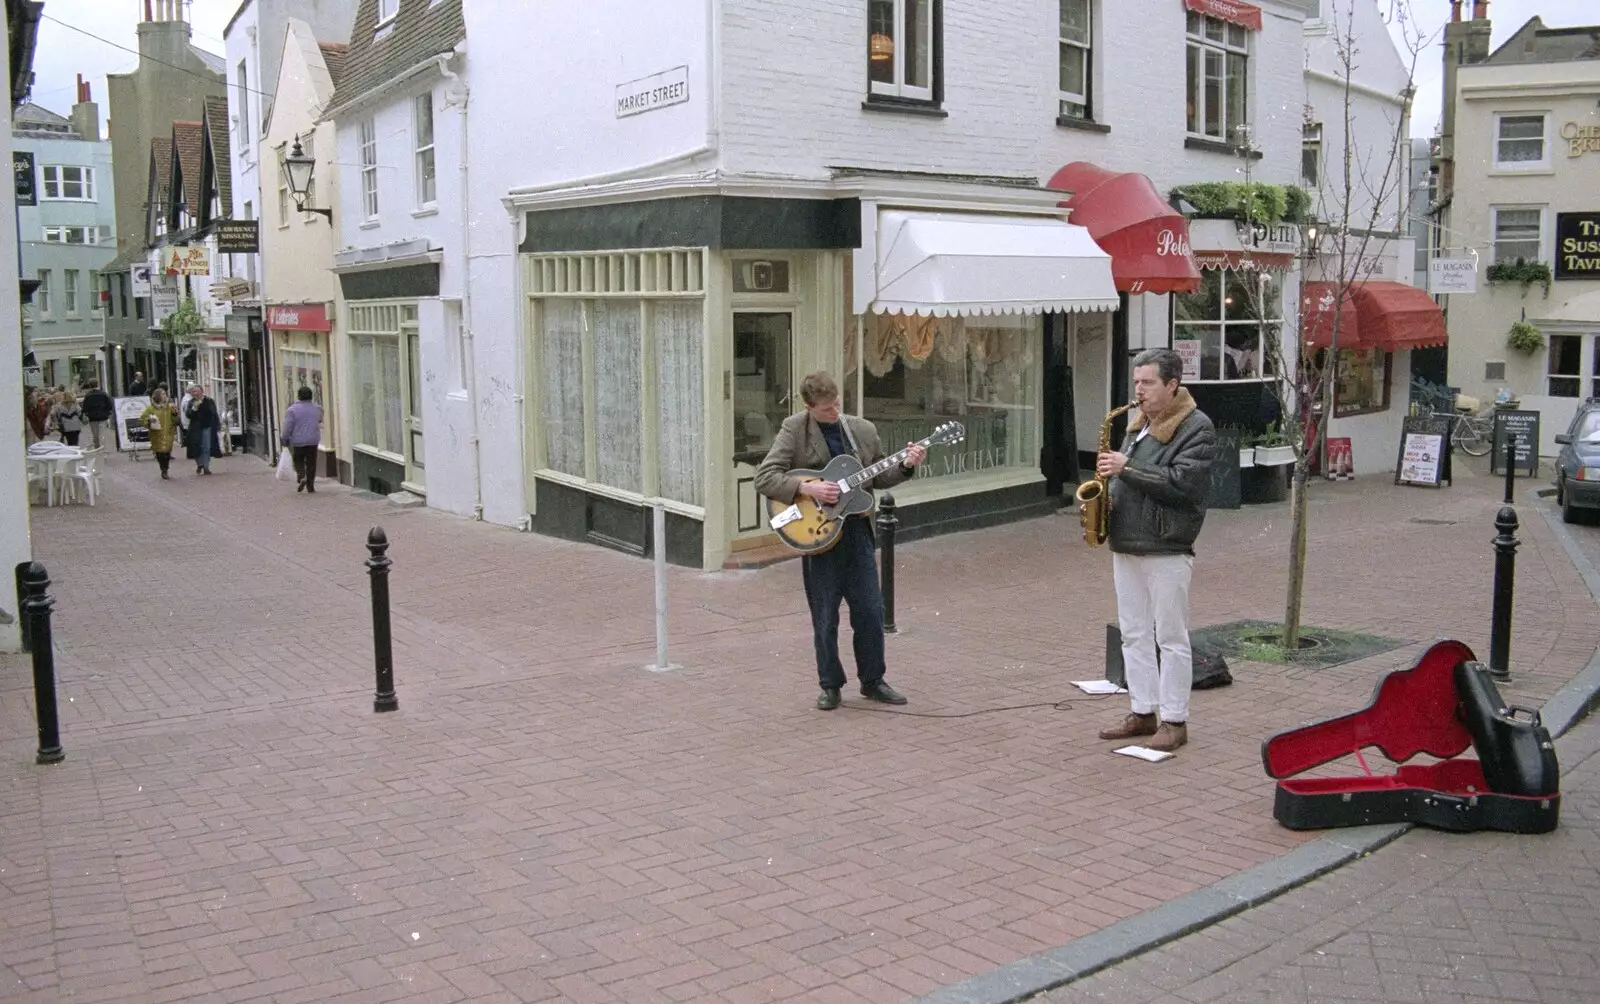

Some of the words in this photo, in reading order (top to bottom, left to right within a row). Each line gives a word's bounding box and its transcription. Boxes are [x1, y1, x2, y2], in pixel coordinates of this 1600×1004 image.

[618, 91, 650, 112] MARKET
[652, 81, 685, 103] STREET
[1563, 237, 1600, 253] SUS
